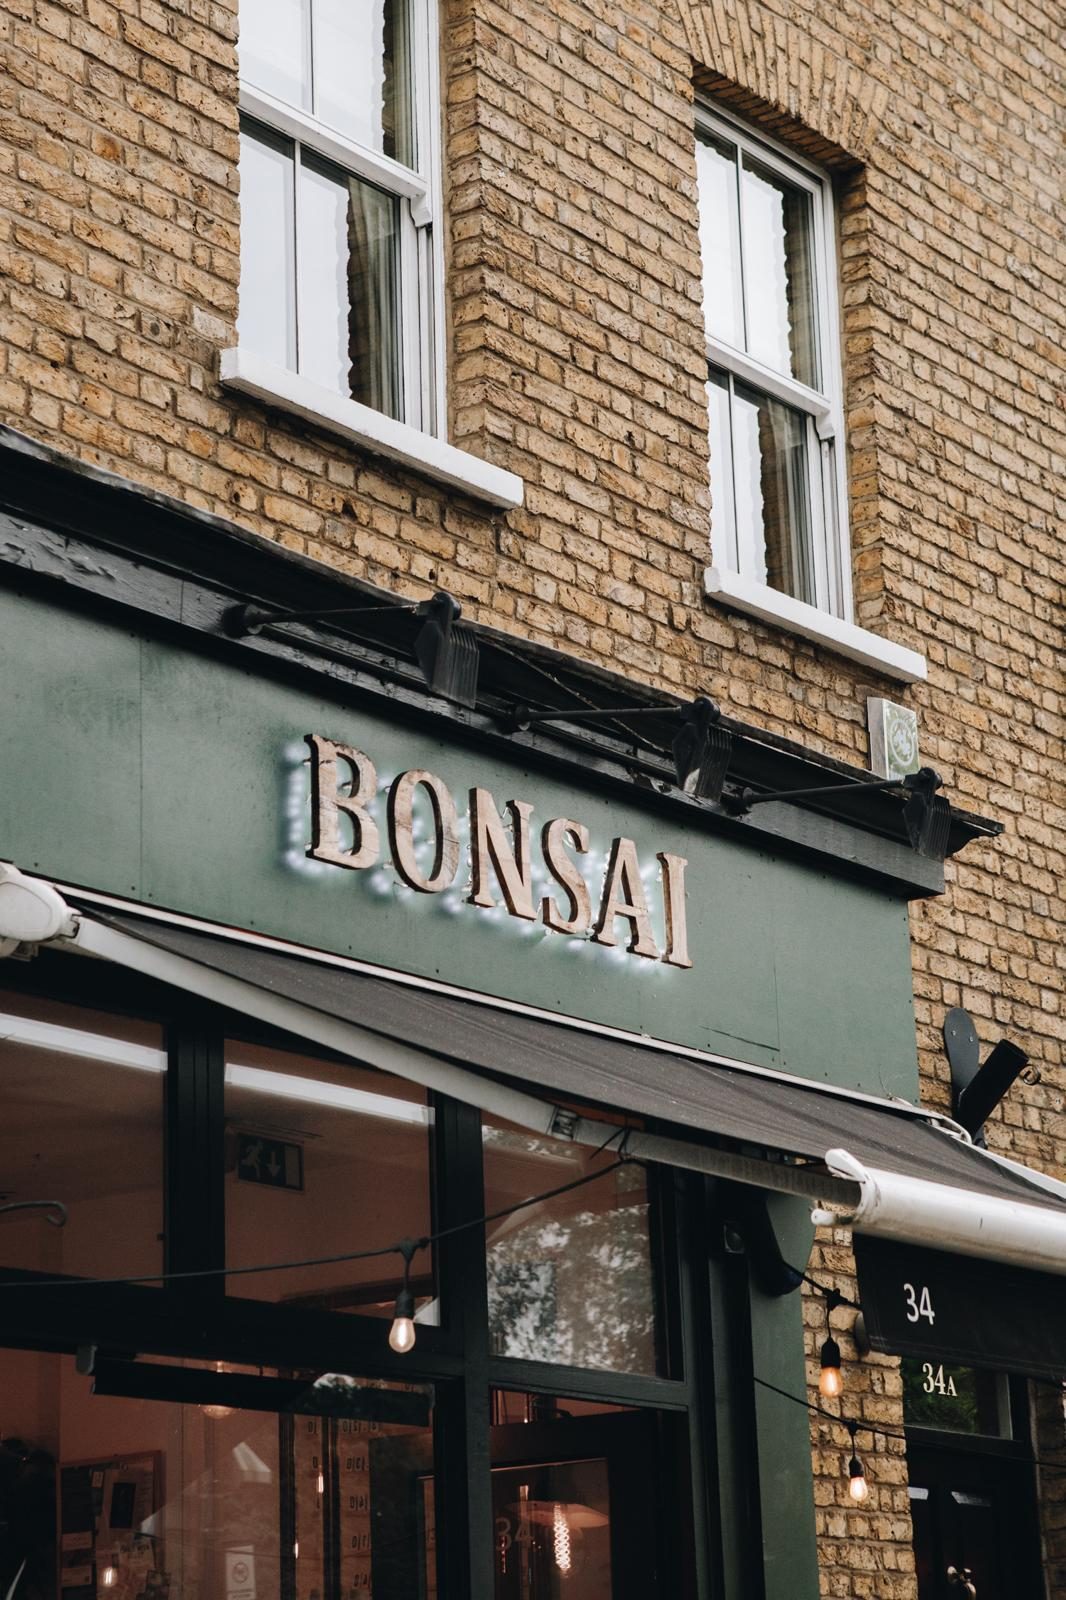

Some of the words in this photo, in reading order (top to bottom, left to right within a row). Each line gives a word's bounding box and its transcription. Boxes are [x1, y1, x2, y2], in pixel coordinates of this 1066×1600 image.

[304, 733, 693, 969] BONSAI
[903, 1283, 935, 1325] 34
[922, 1362, 958, 1397] 34A
